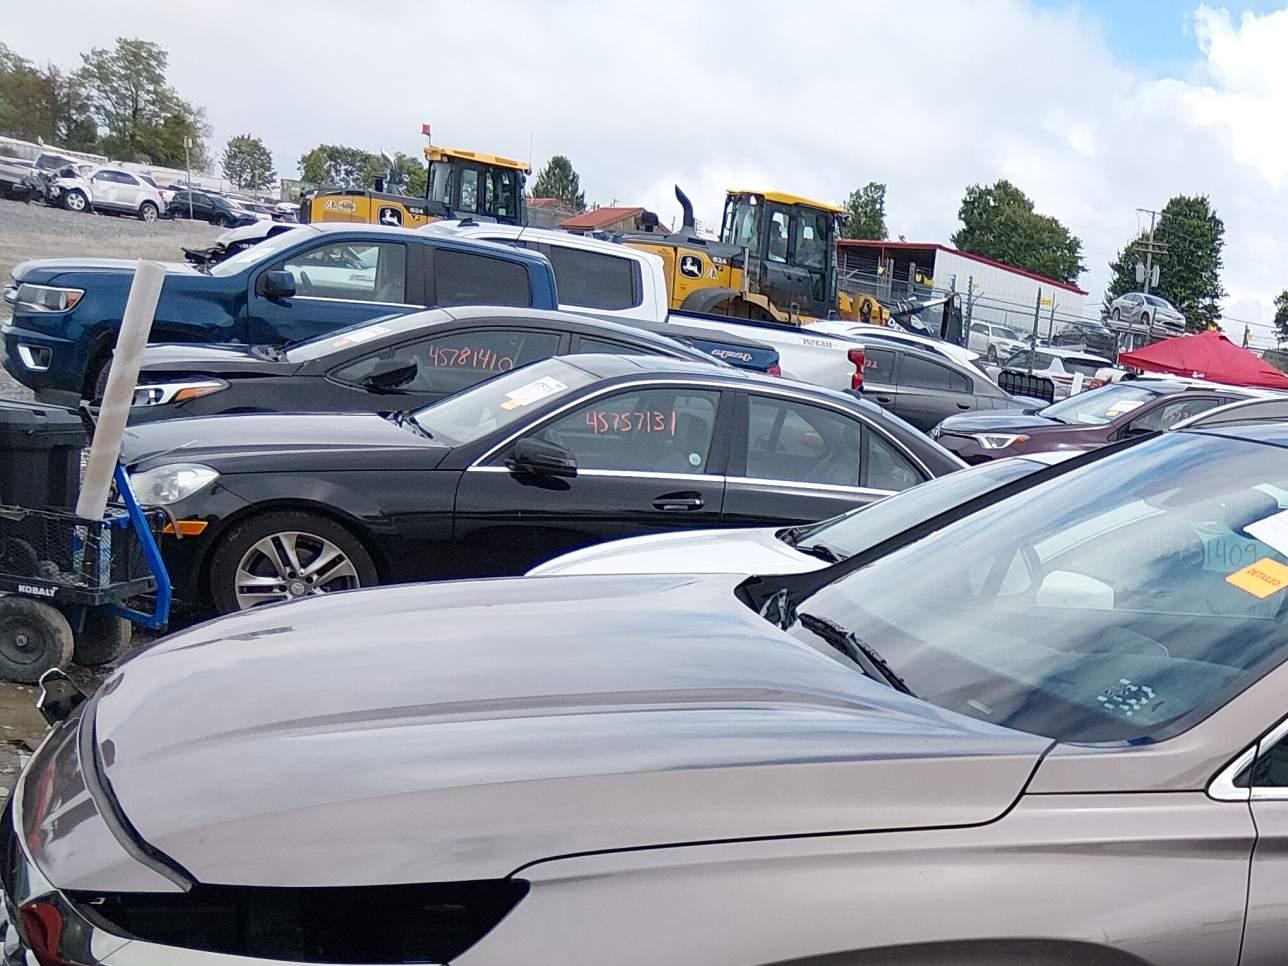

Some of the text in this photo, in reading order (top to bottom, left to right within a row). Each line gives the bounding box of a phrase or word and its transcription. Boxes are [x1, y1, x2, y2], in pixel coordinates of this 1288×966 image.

[429, 345, 513, 373] 45781410
[586, 411, 676, 436] 45757131
[18, 584, 59, 597] KOBALT
